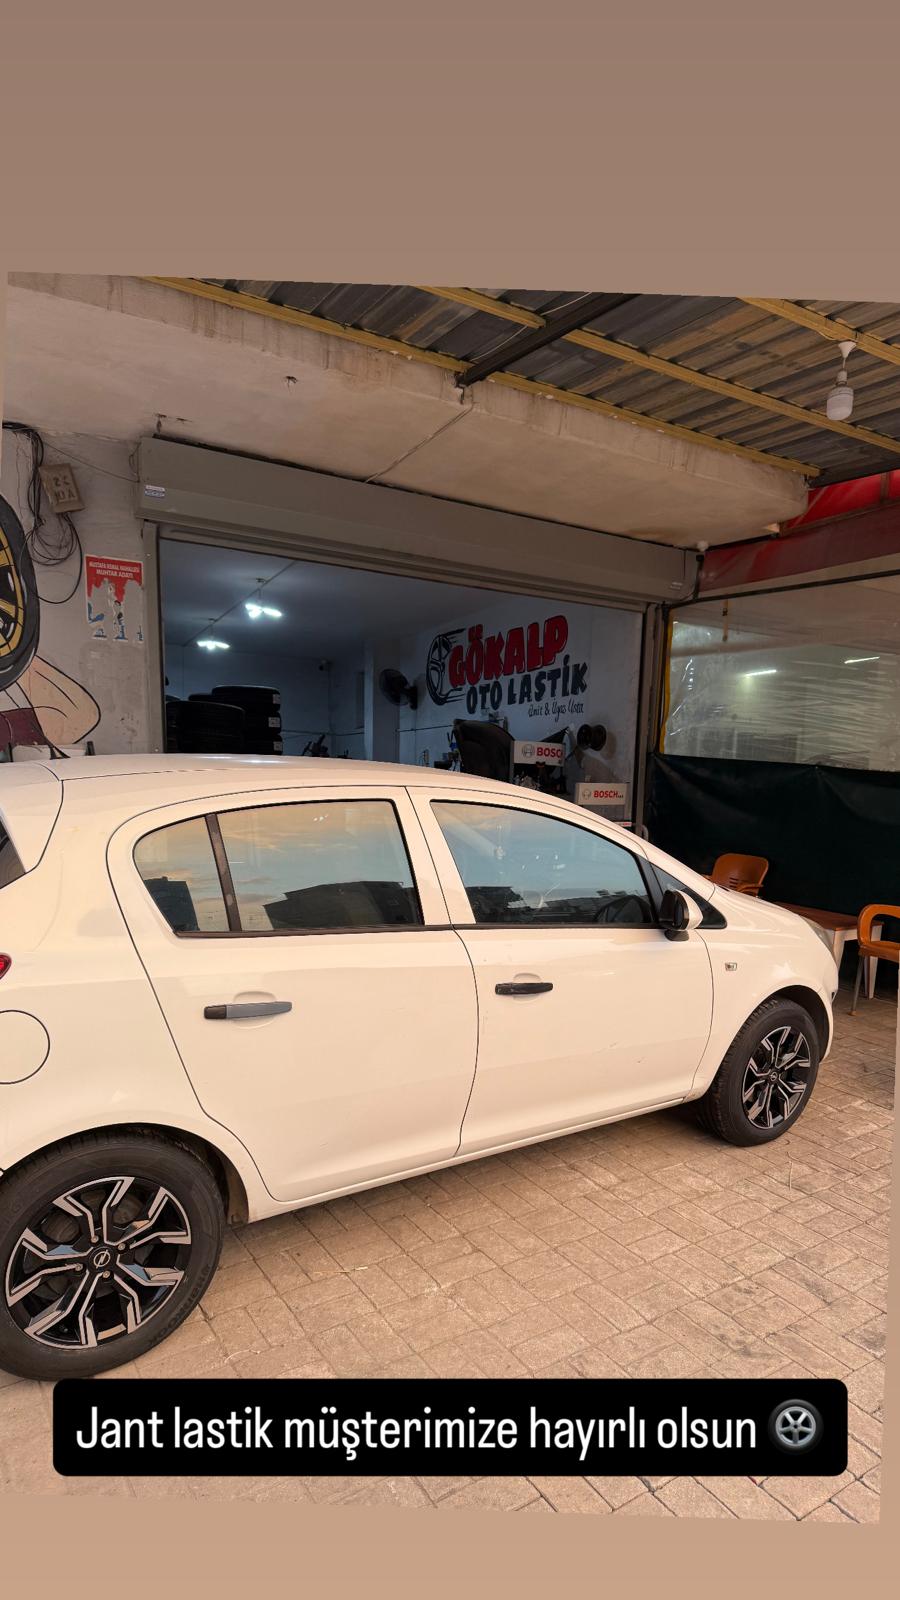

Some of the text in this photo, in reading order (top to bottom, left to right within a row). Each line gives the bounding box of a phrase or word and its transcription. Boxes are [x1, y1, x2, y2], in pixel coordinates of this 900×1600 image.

[448, 615, 568, 688] GÖKALP
[466, 654, 588, 715] OTO LASTİK
